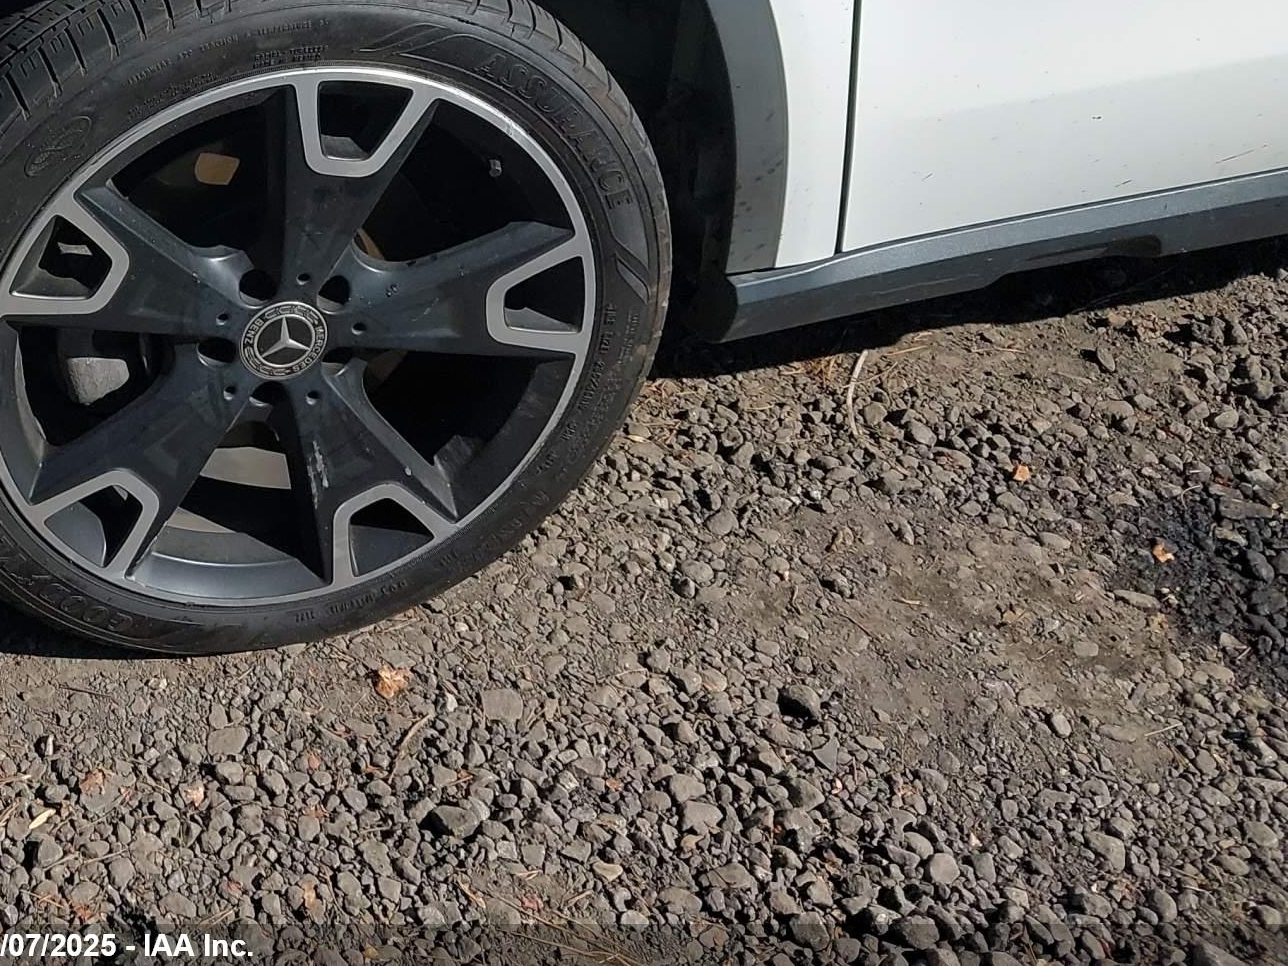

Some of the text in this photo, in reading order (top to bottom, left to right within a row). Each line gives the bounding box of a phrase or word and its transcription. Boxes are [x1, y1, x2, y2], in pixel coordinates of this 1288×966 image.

[477, 52, 632, 210] ASSURANCE
[244, 319, 265, 345] BENZ
[293, 326, 325, 372] MERCEDES
